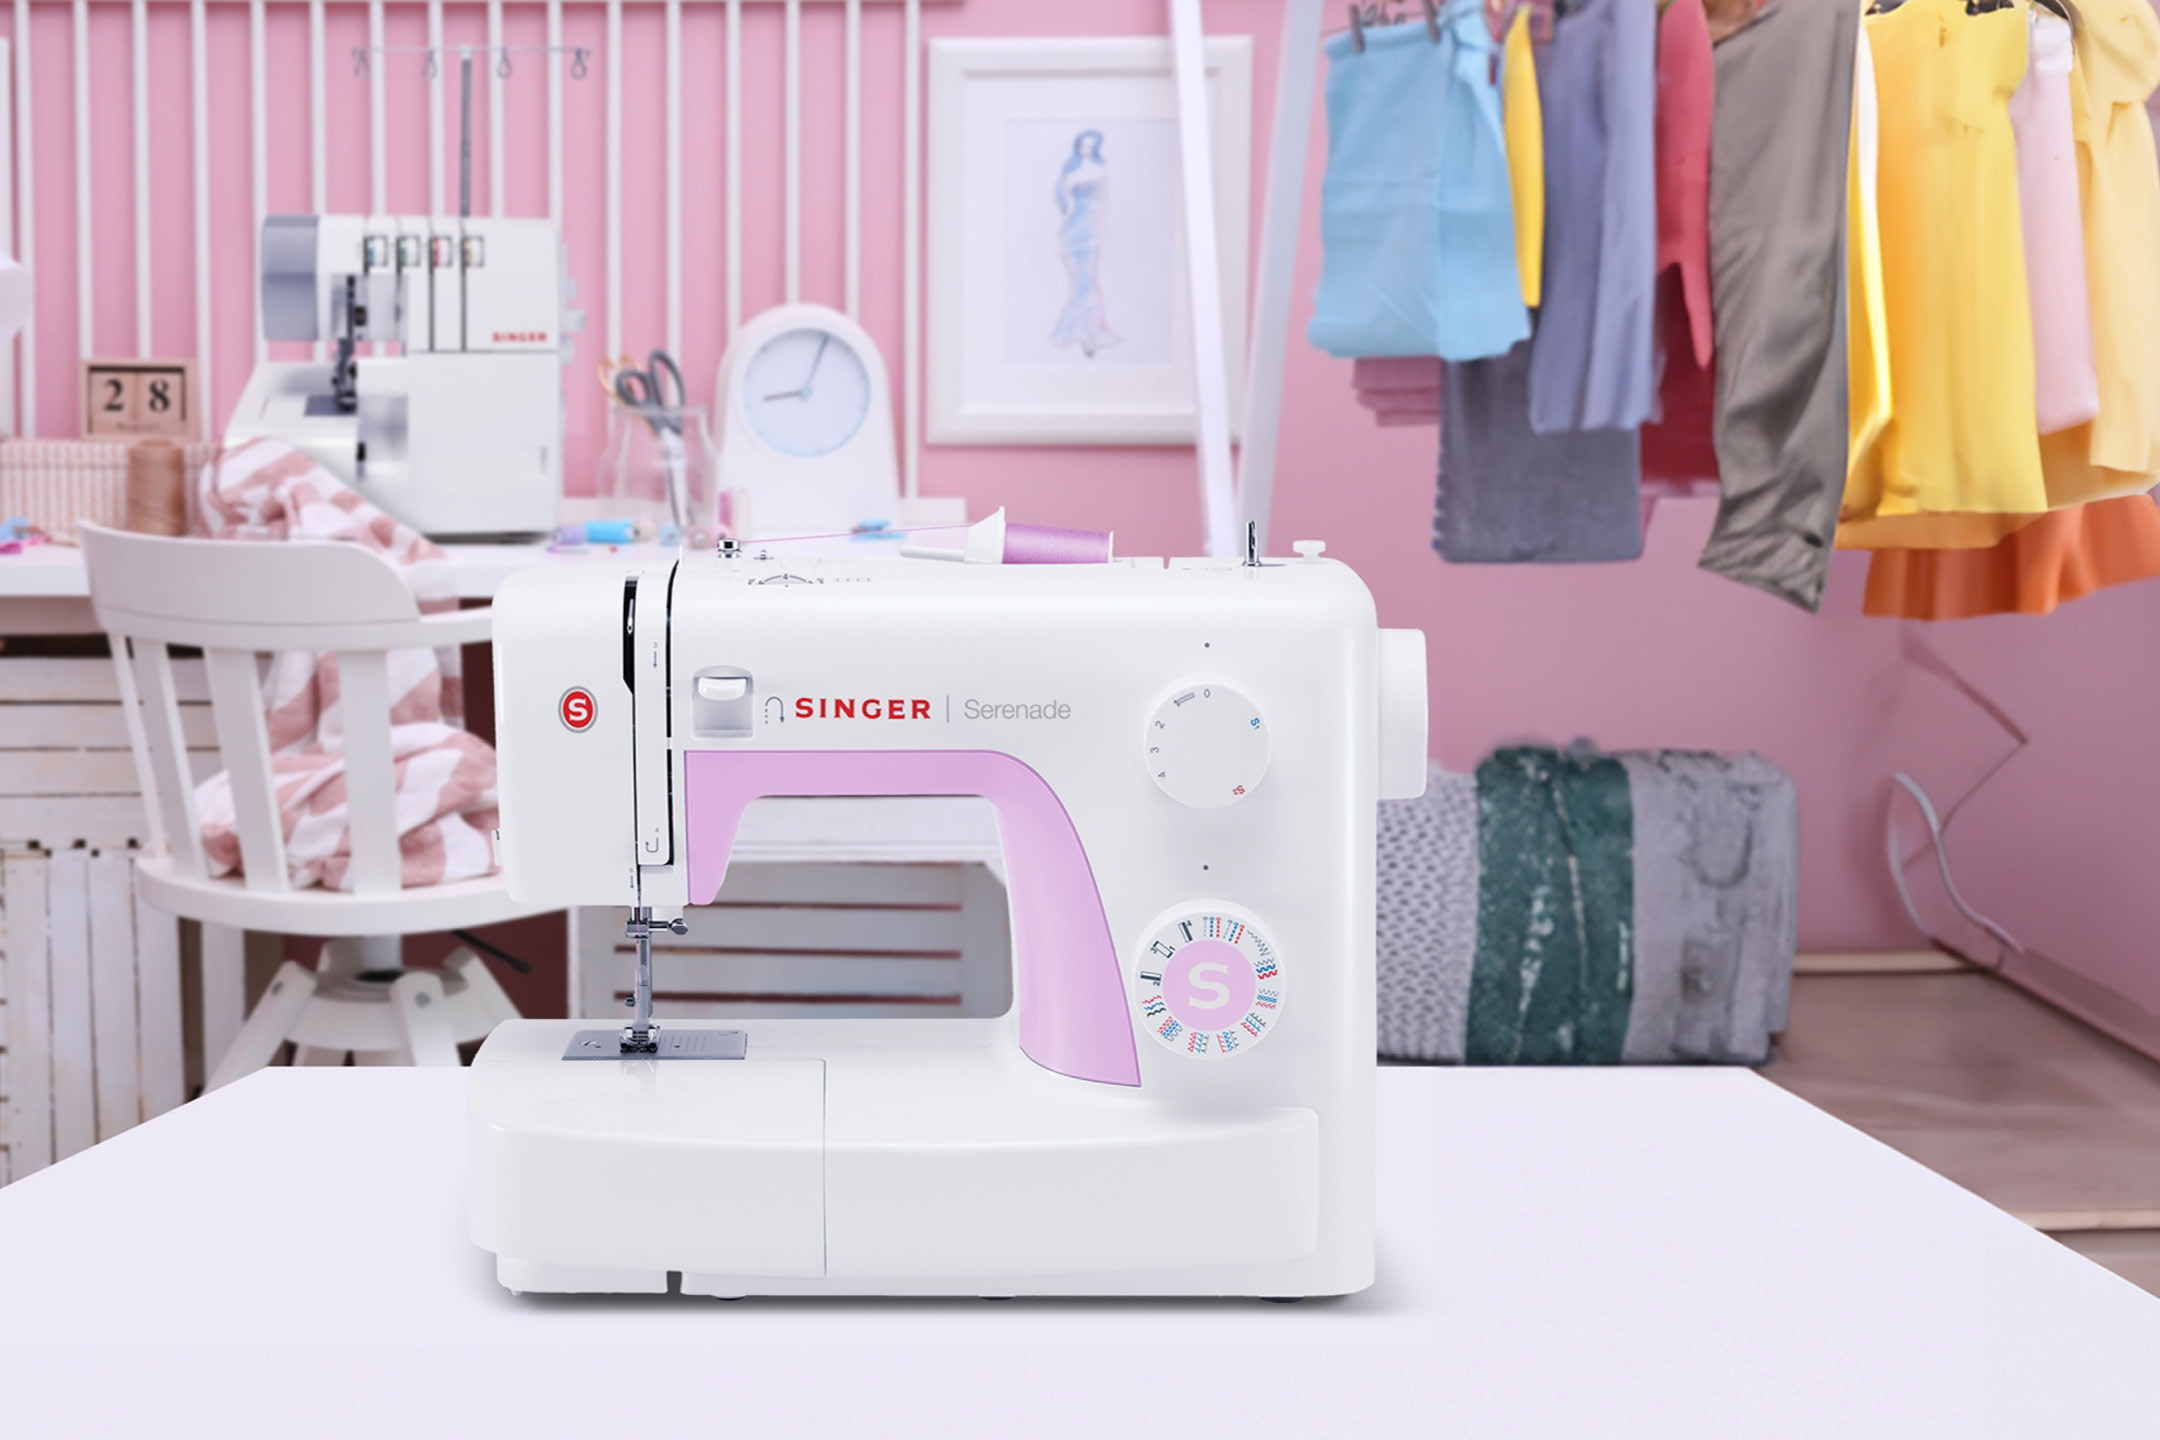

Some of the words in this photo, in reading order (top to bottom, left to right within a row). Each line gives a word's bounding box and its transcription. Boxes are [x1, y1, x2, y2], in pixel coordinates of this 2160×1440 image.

[492, 332, 547, 342] SINGER
[104, 379, 124, 412] 2
[149, 379, 171, 412] 8
[1203, 688, 1211, 699] 0
[568, 697, 589, 722] S
[794, 696, 932, 720] SINGER
[963, 697, 1072, 720] Serenade
[1154, 720, 1165, 729] 2
[1149, 746, 1160, 754] 3
[1188, 962, 1231, 1010] S
